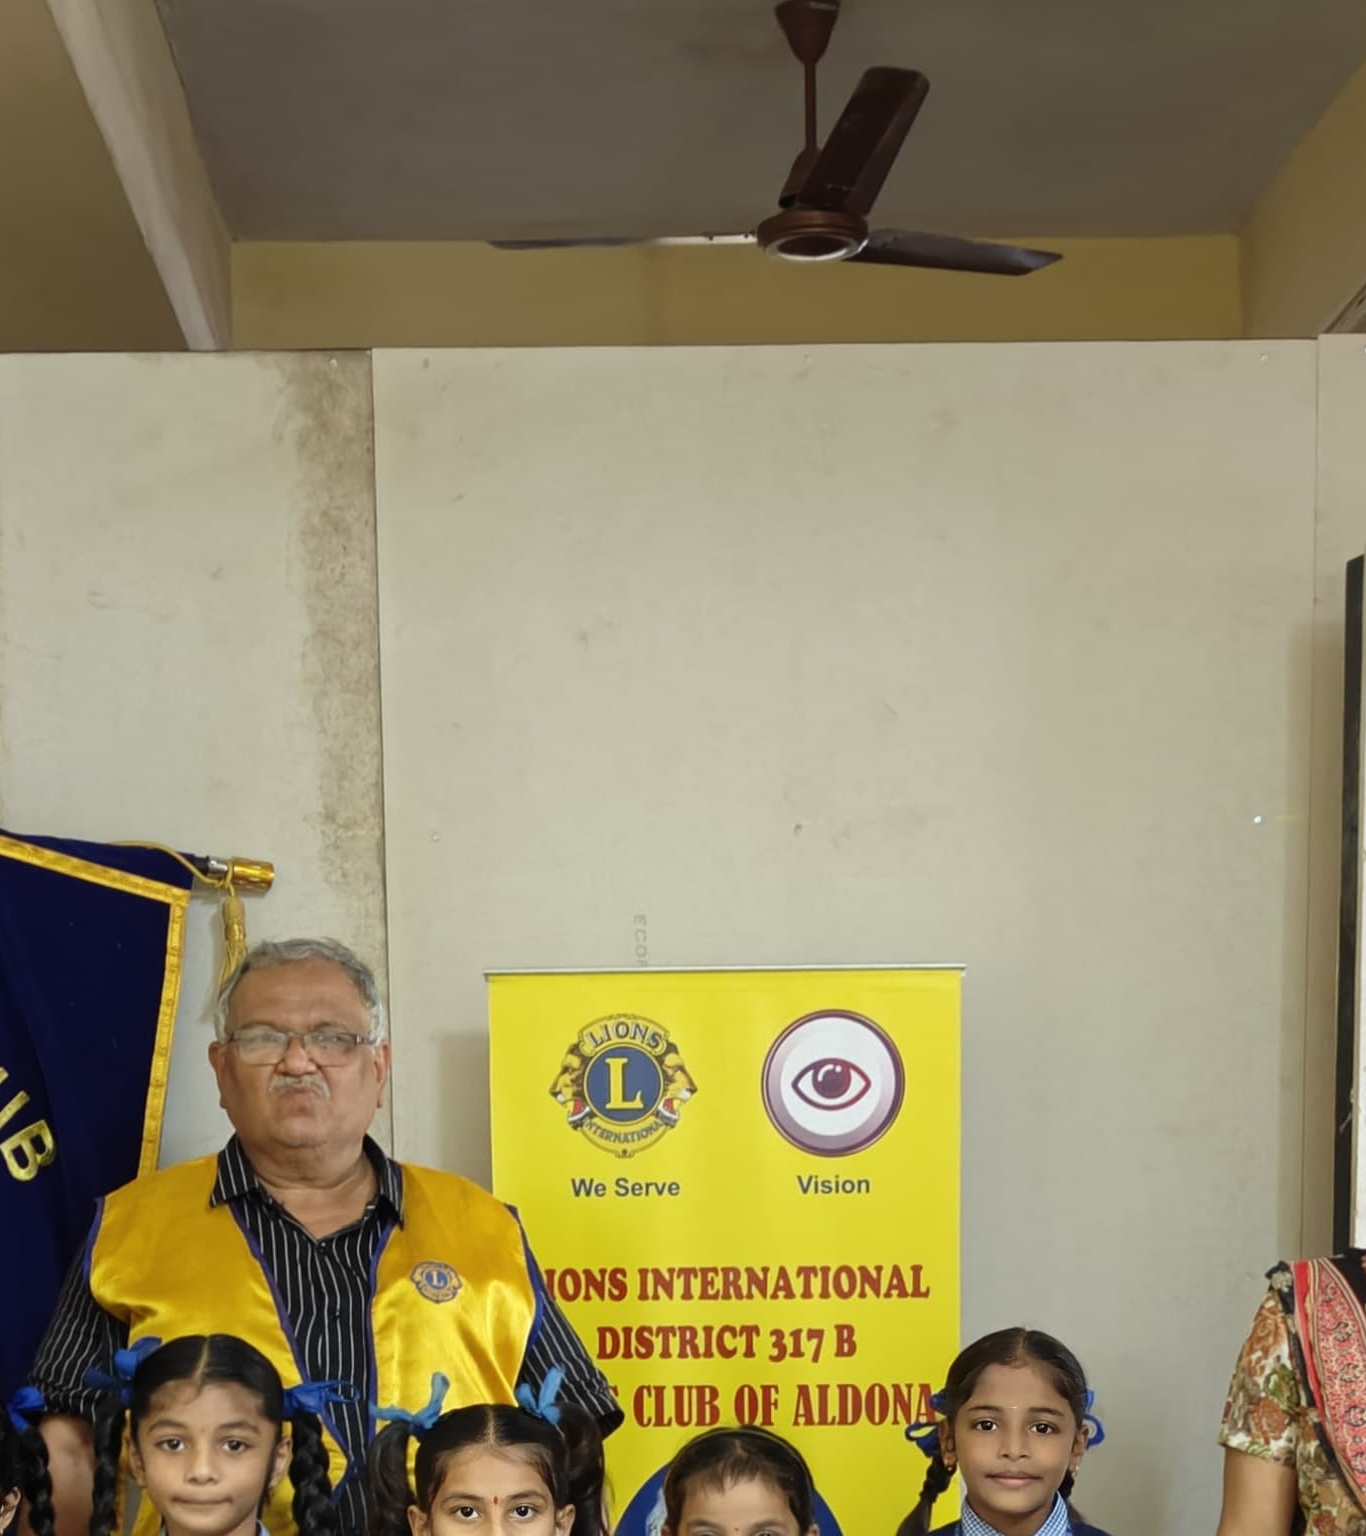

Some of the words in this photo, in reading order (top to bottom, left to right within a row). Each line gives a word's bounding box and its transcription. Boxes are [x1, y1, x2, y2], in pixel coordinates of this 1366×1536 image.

[588, 1020, 663, 1049] LIONS
[605, 1057, 644, 1110] L
[571, 1178, 607, 1198] We
[614, 1177, 681, 1197] Serve
[796, 1174, 871, 1195] Vision
[545, 1267, 628, 1302] IONS
[637, 1264, 930, 1301] INTERNATIONAL
[596, 1324, 760, 1361] DISTRICT
[768, 1327, 825, 1364] 317
[834, 1324, 858, 1359] B
[632, 1384, 721, 1428] CLUB
[734, 1384, 780, 1426] OF
